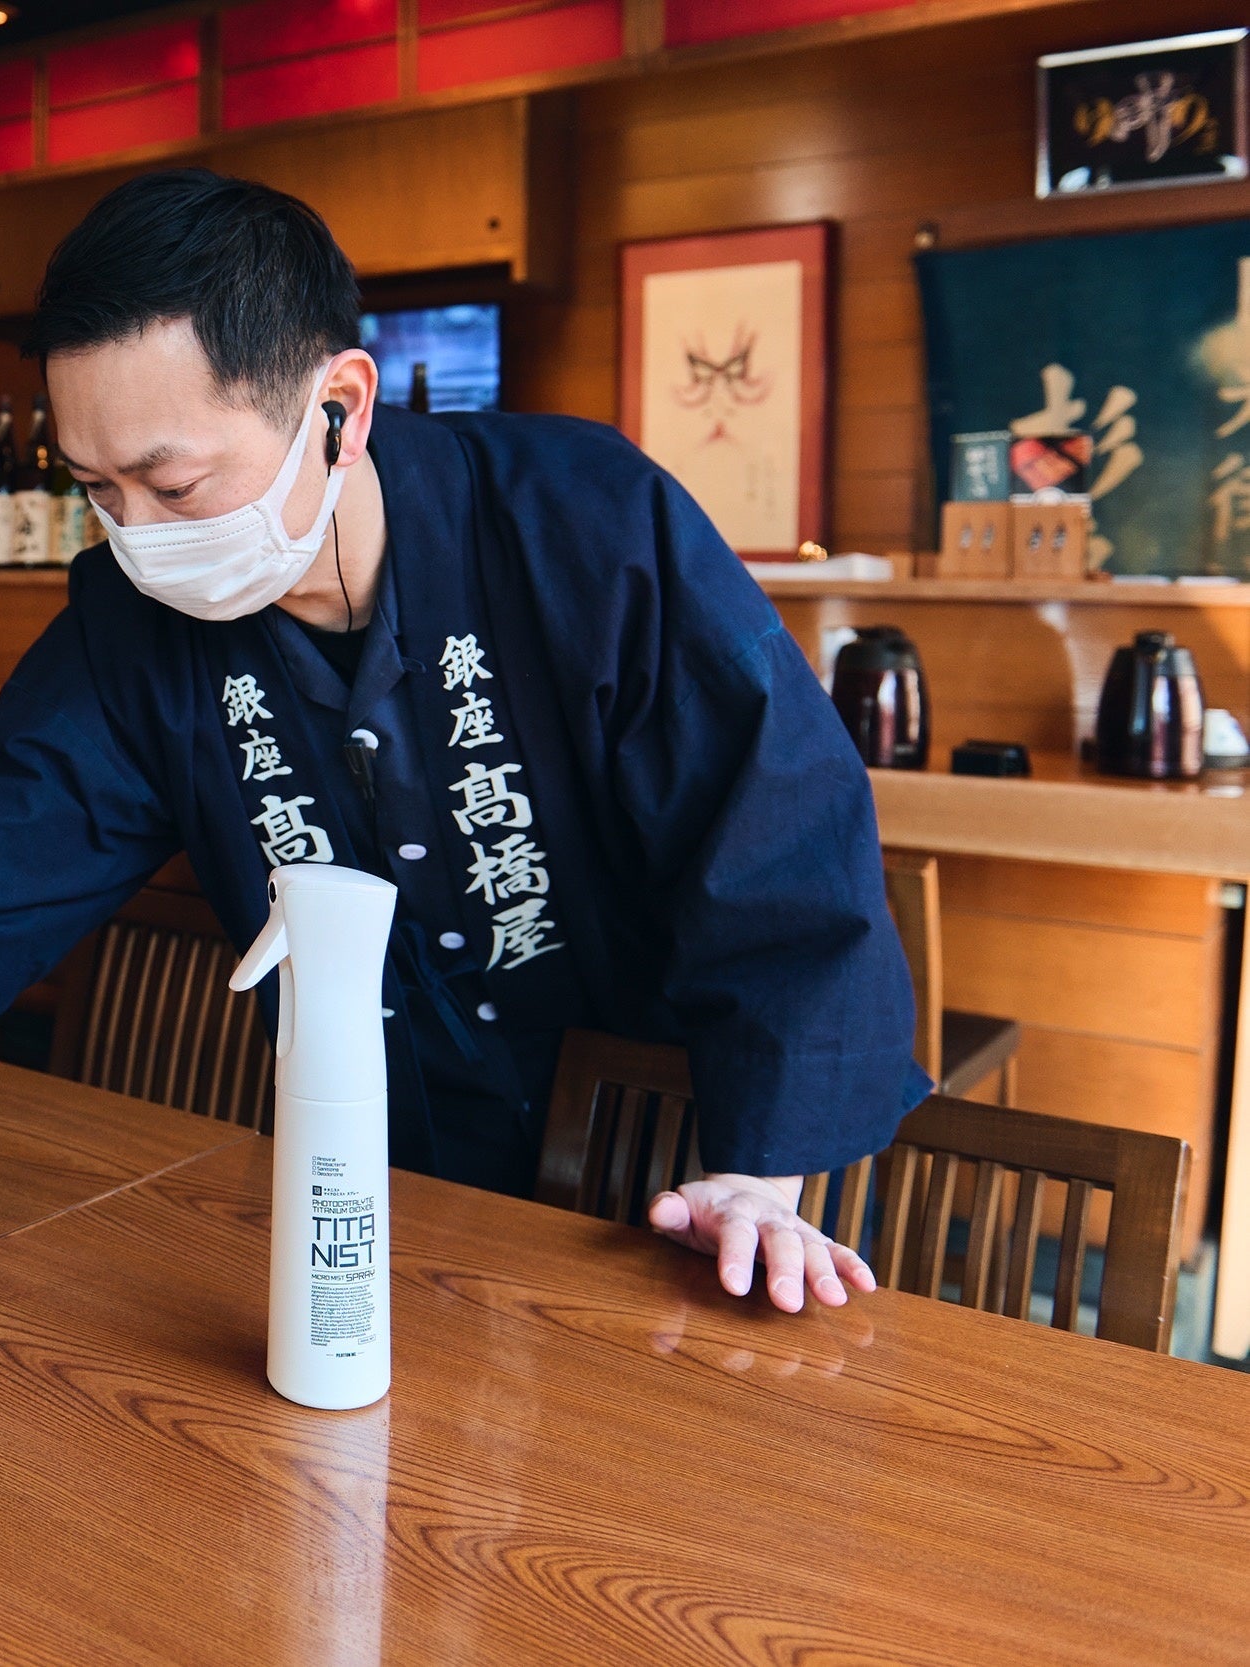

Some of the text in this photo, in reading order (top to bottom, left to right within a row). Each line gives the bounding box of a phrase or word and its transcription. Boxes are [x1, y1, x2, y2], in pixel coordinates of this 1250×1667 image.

[312, 1203, 374, 1214] TITANIUM DIOXIDE
[312, 1213, 375, 1241] TITA
[312, 1239, 375, 1268] NIST
[346, 1269, 375, 1282] SPRAY
